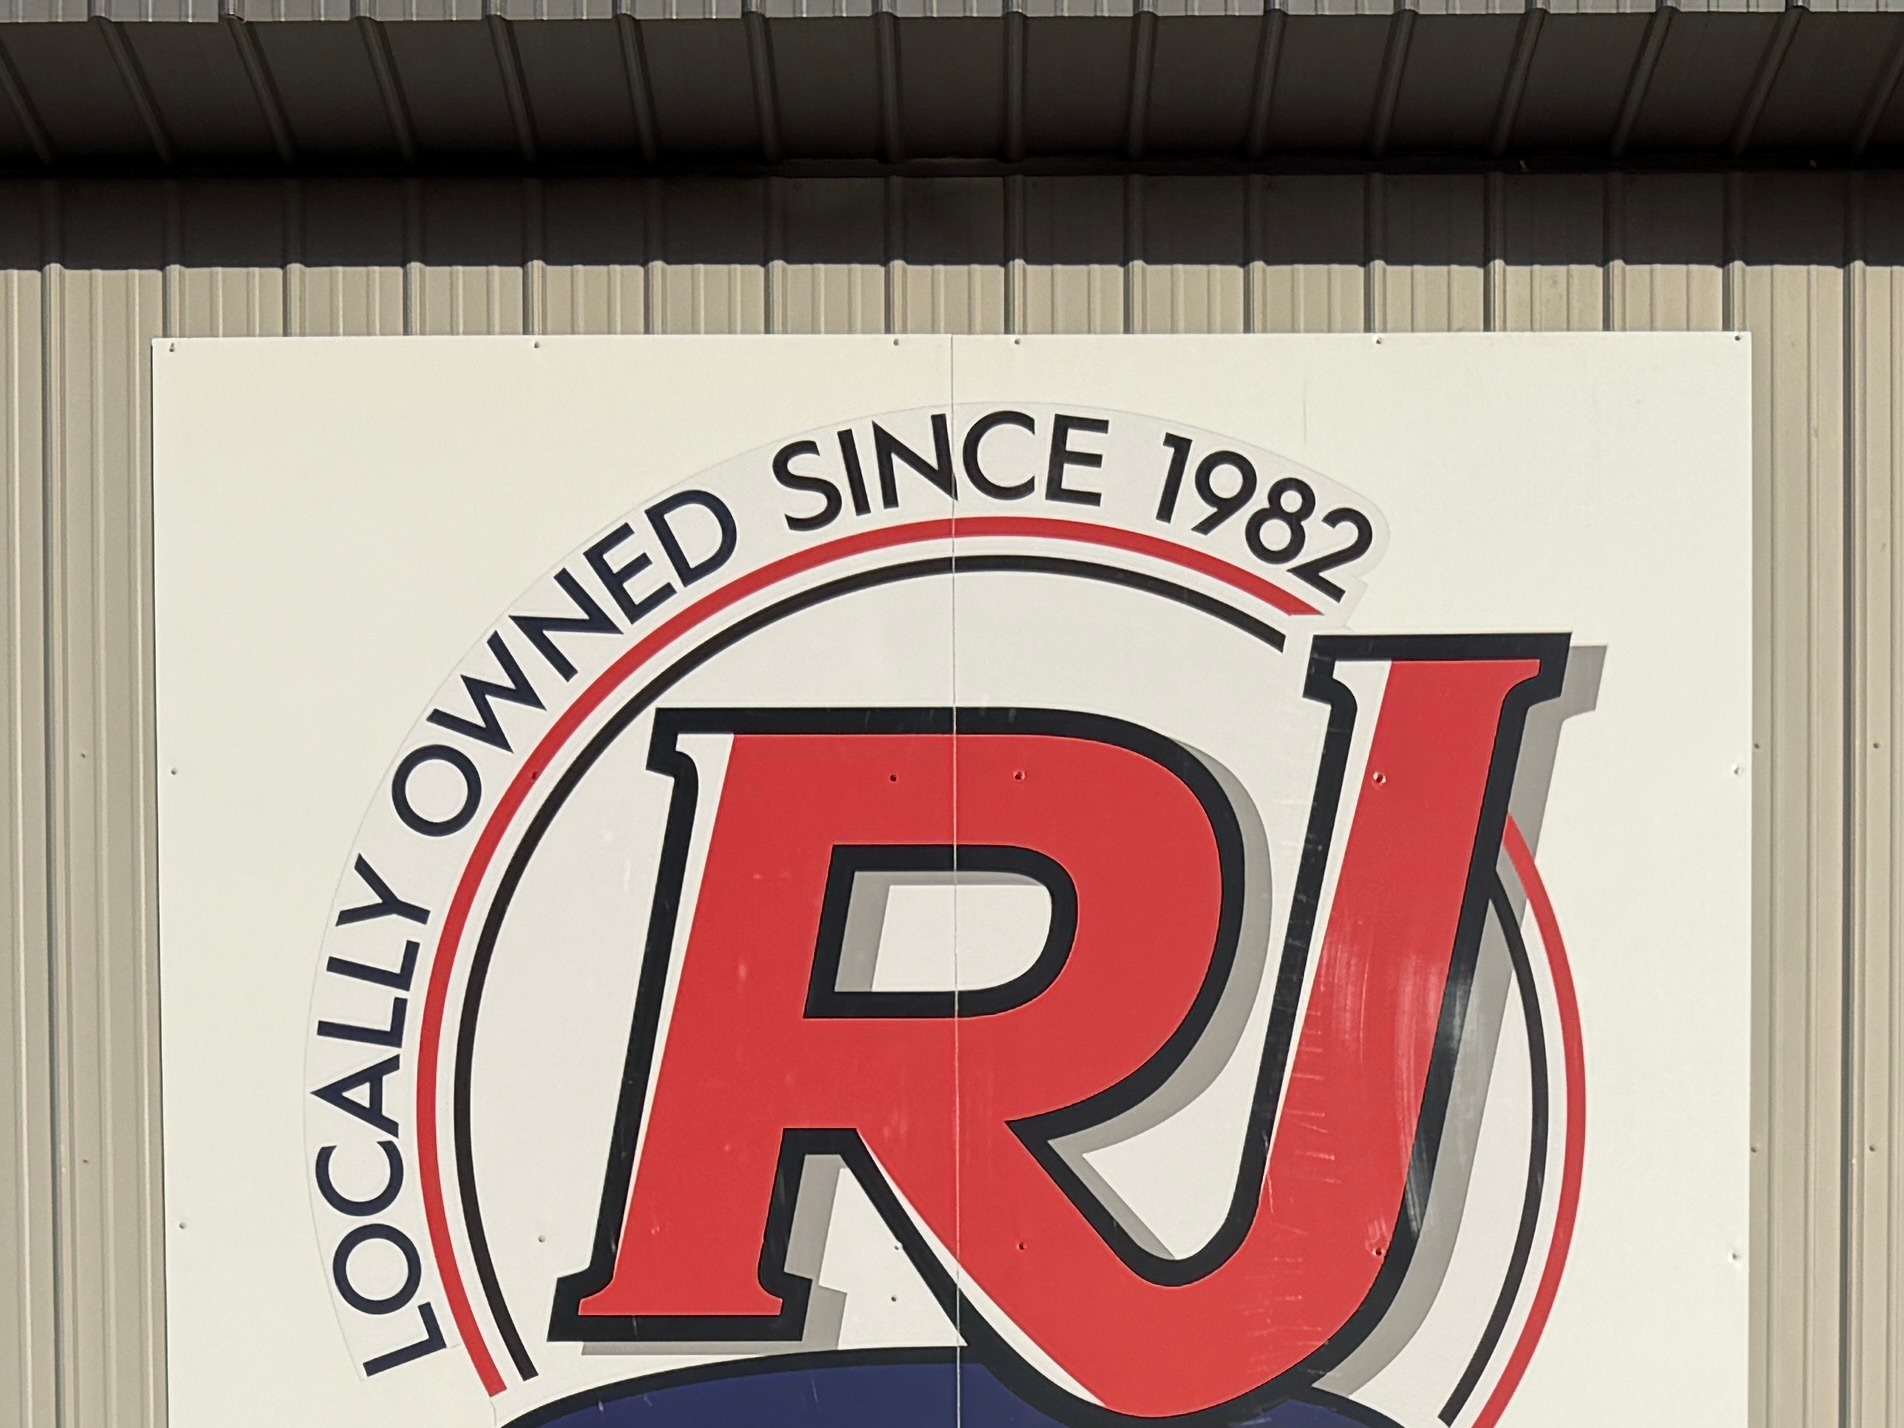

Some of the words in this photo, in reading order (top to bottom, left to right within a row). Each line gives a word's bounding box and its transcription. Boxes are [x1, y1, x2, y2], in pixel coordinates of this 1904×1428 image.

[311, 854, 446, 1377] LOCALLY
[392, 490, 737, 837] OWNED
[772, 411, 1110, 531] SINCE
[1156, 432, 1373, 603] 1982
